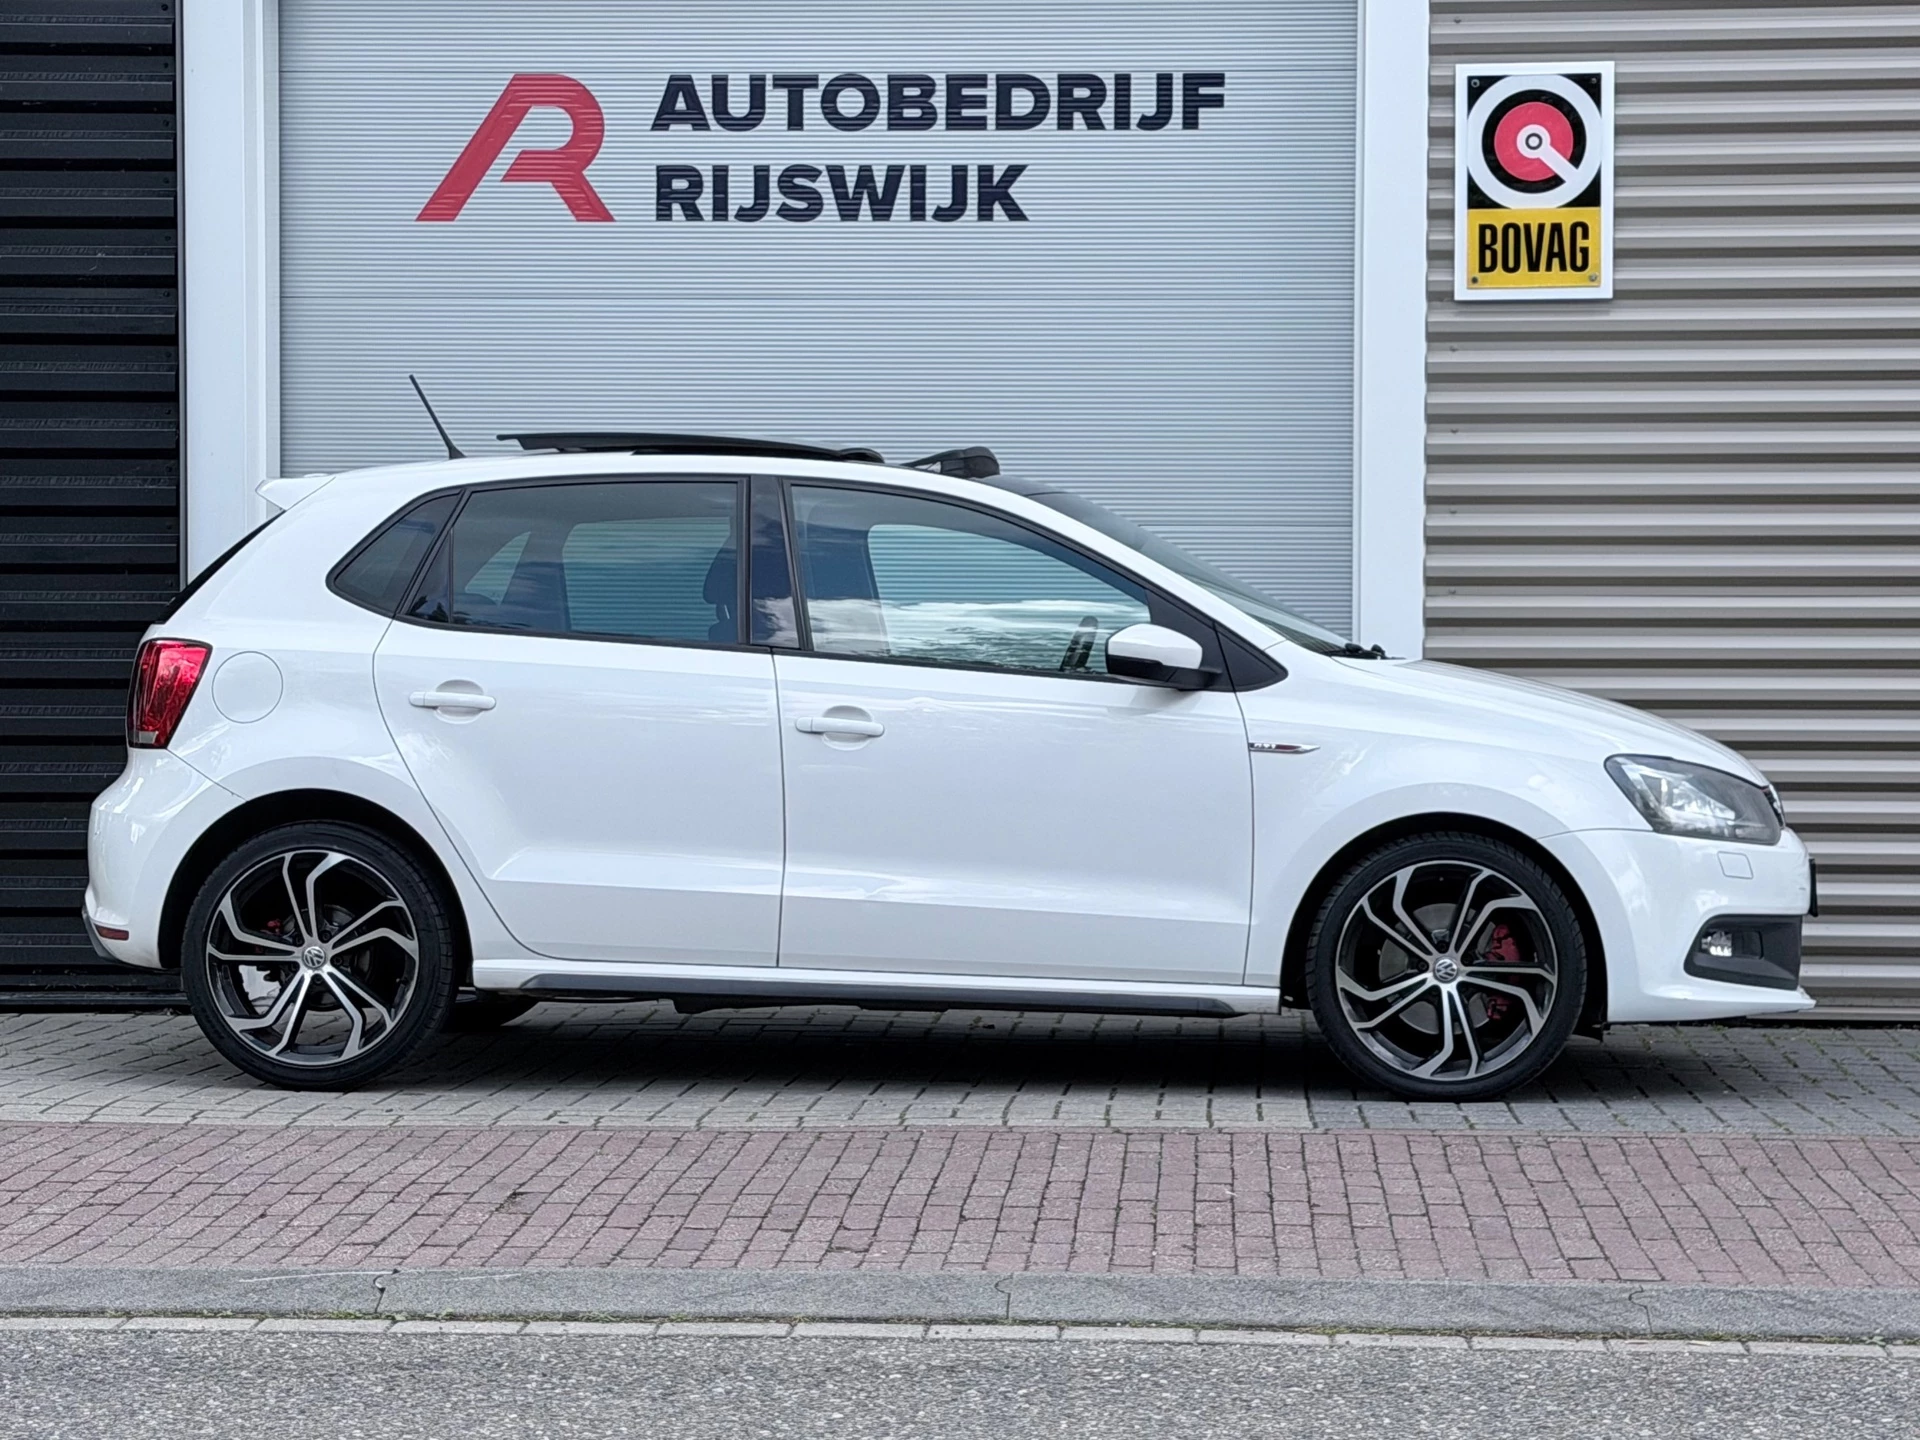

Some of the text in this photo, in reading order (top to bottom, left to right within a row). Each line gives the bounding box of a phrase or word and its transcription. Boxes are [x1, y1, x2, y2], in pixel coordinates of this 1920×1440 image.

[651, 73, 1226, 132] AUTOBEDRIJF
[655, 164, 1030, 222] RIJSWIJK
[1478, 221, 1590, 274] BOVAG
